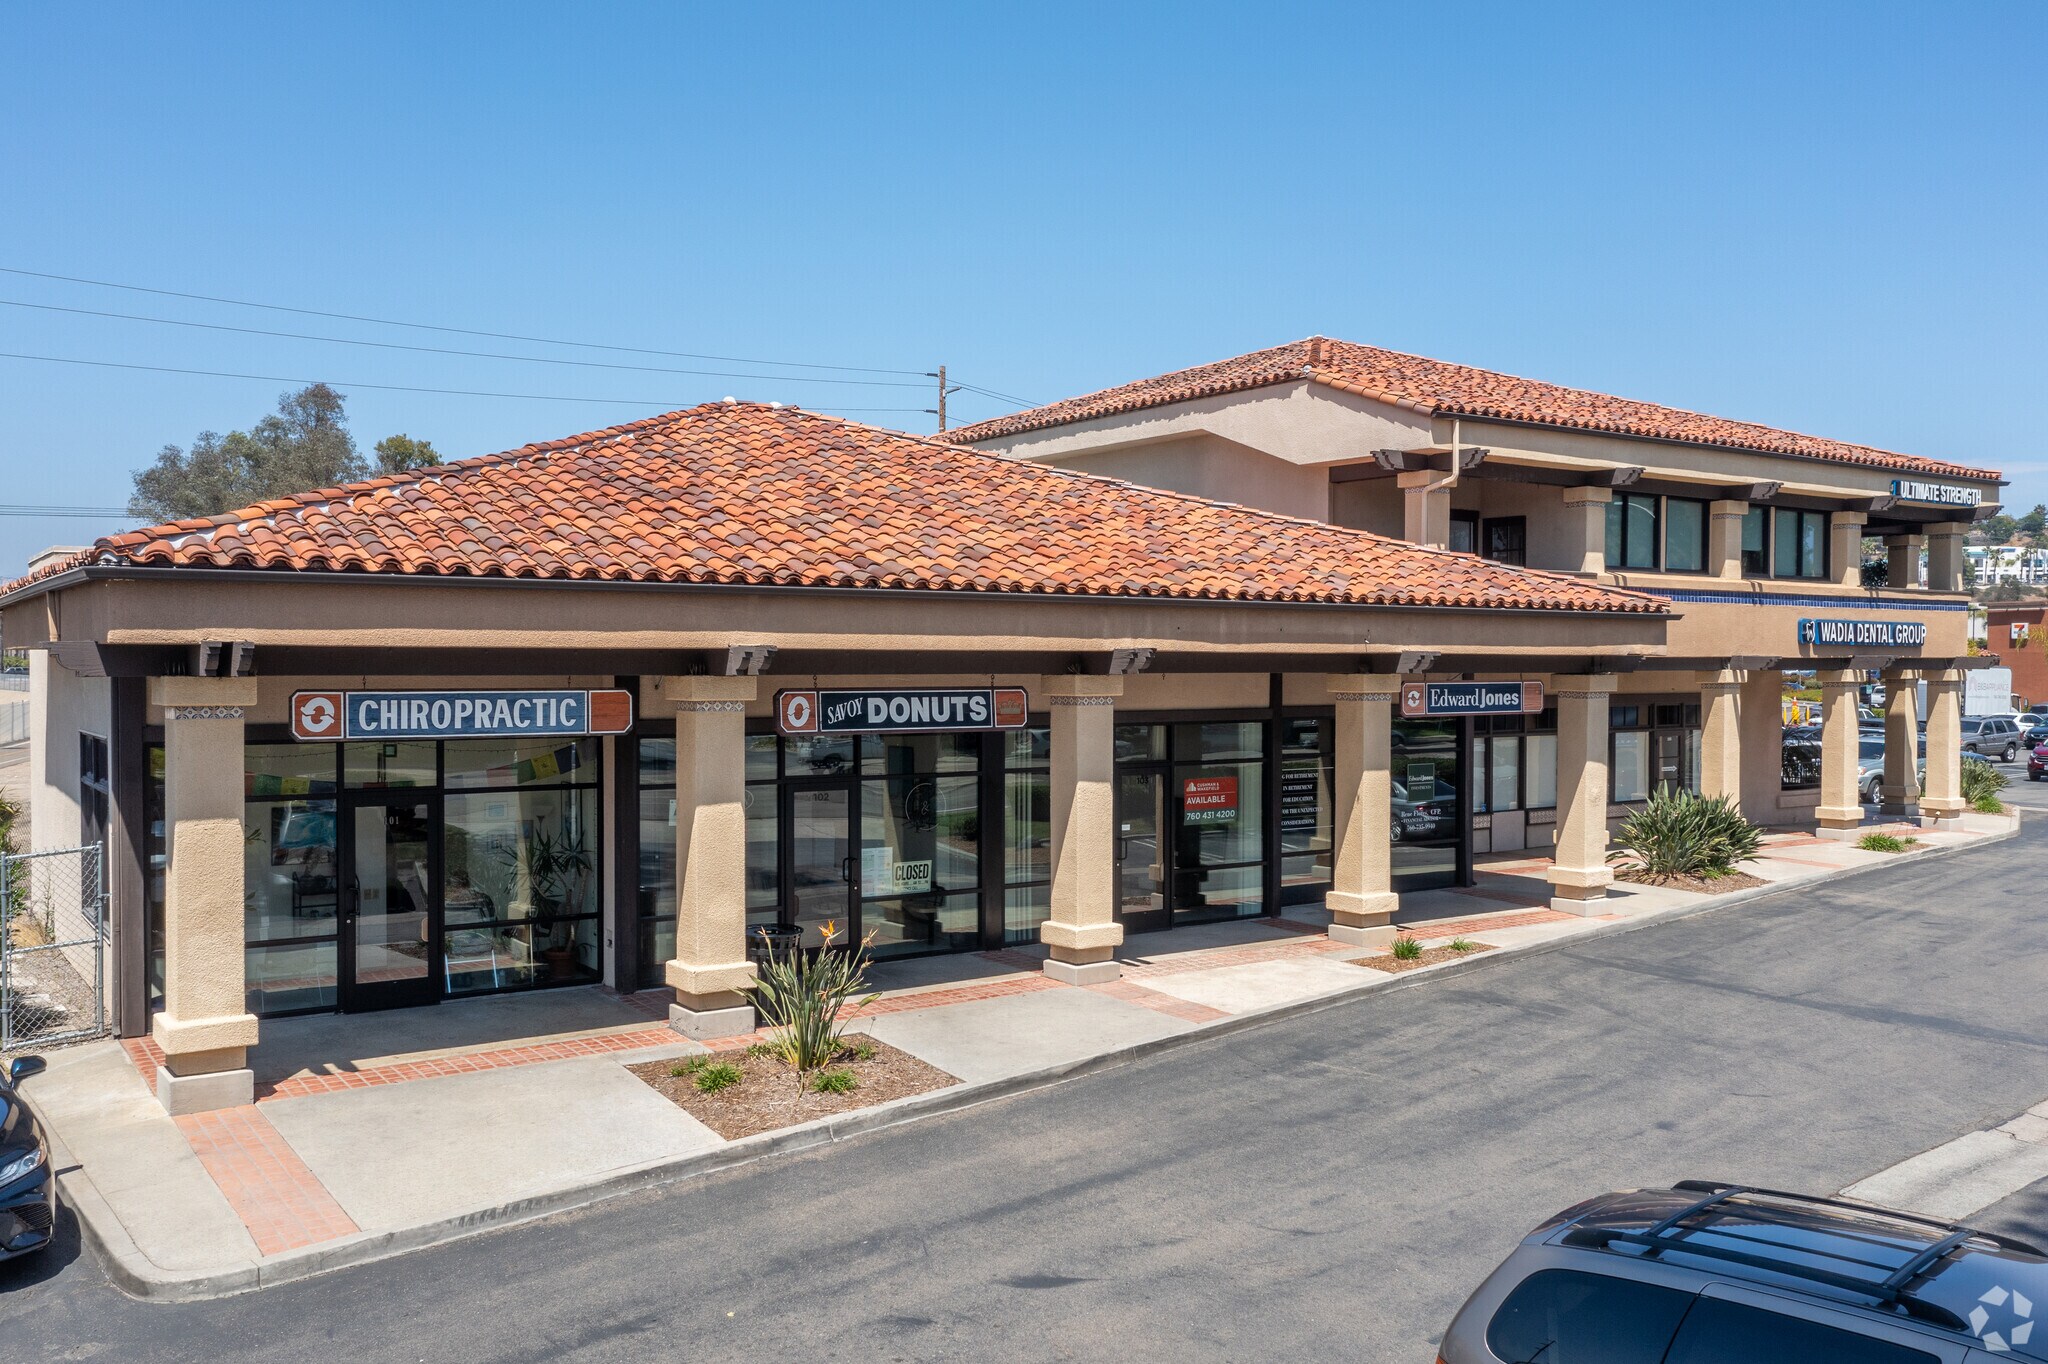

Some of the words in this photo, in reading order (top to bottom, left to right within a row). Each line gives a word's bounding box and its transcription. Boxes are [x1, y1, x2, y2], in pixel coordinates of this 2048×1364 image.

[1900, 481, 1940, 501] ULTIMATE
[1940, 485, 1982, 505] STRENGTH
[1820, 622, 1855, 642] WADIA
[1857, 623, 1894, 643] DENTAL
[1895, 625, 1927, 644] GROUP
[358, 698, 577, 731] CHIROPRACTIC
[827, 697, 863, 724] SAVOY
[867, 695, 987, 724] DONUTS
[813, 792, 830, 802] 102
[1186, 795, 1226, 805] AVAILABLE
[1186, 812, 1201, 821] 760
[1202, 811, 1215, 819] 431
[1216, 809, 1236, 818] 4200
[895, 863, 929, 881] CLOSED
